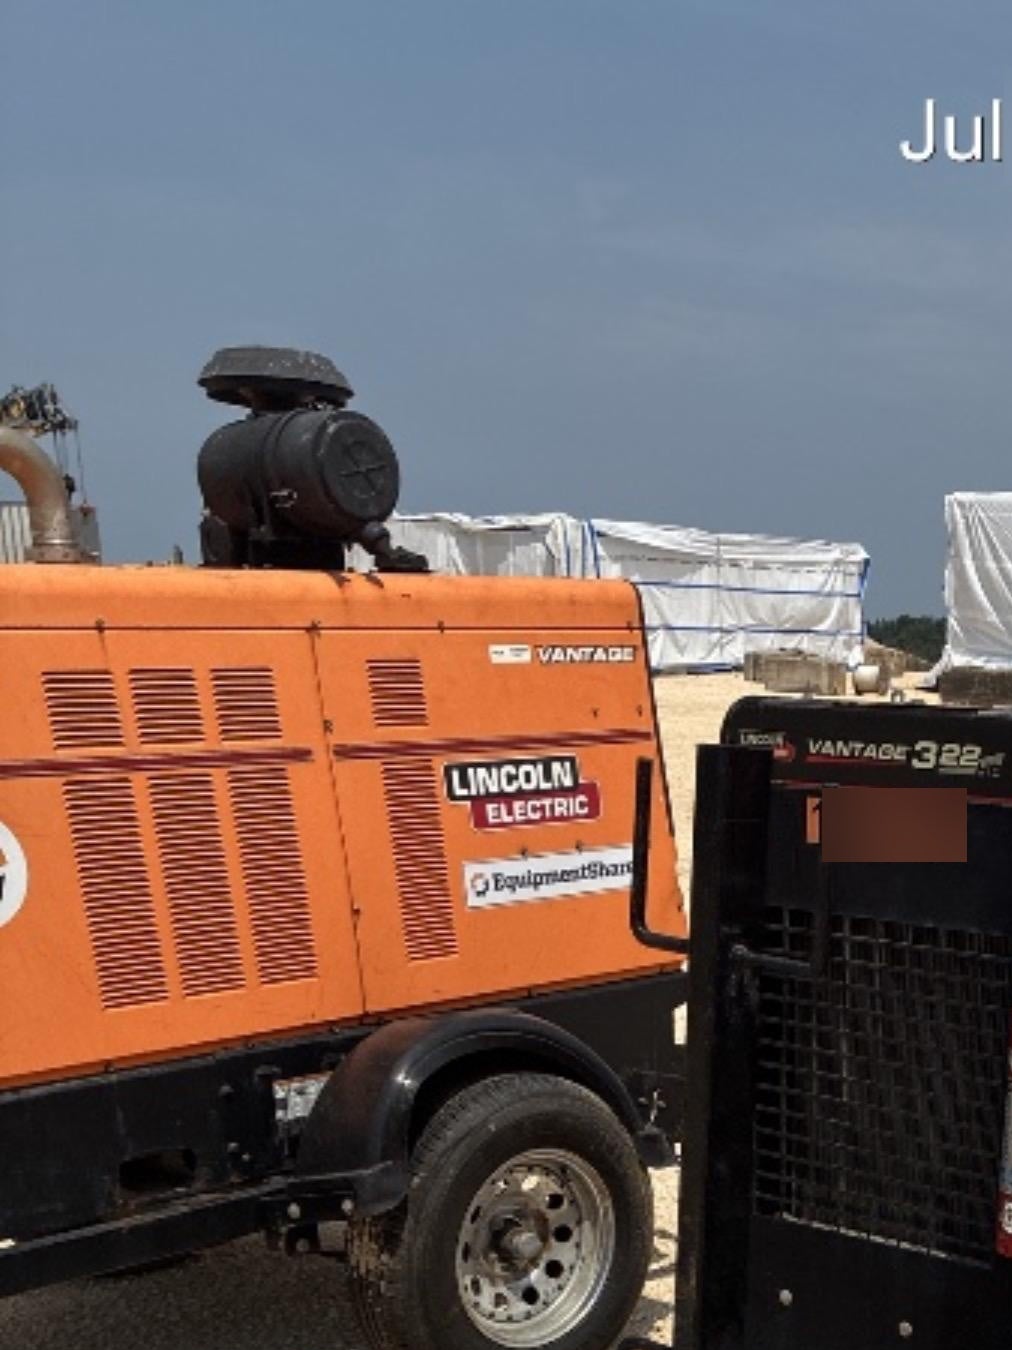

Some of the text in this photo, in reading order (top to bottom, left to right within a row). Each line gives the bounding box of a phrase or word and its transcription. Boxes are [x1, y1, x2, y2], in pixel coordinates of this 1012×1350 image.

[537, 645, 634, 663] VANTAGE
[808, 738, 911, 761] VANTAGE
[911, 740, 982, 770] 322
[451, 761, 573, 797] LINCOLN
[487, 796, 589, 823] ELECTRIC
